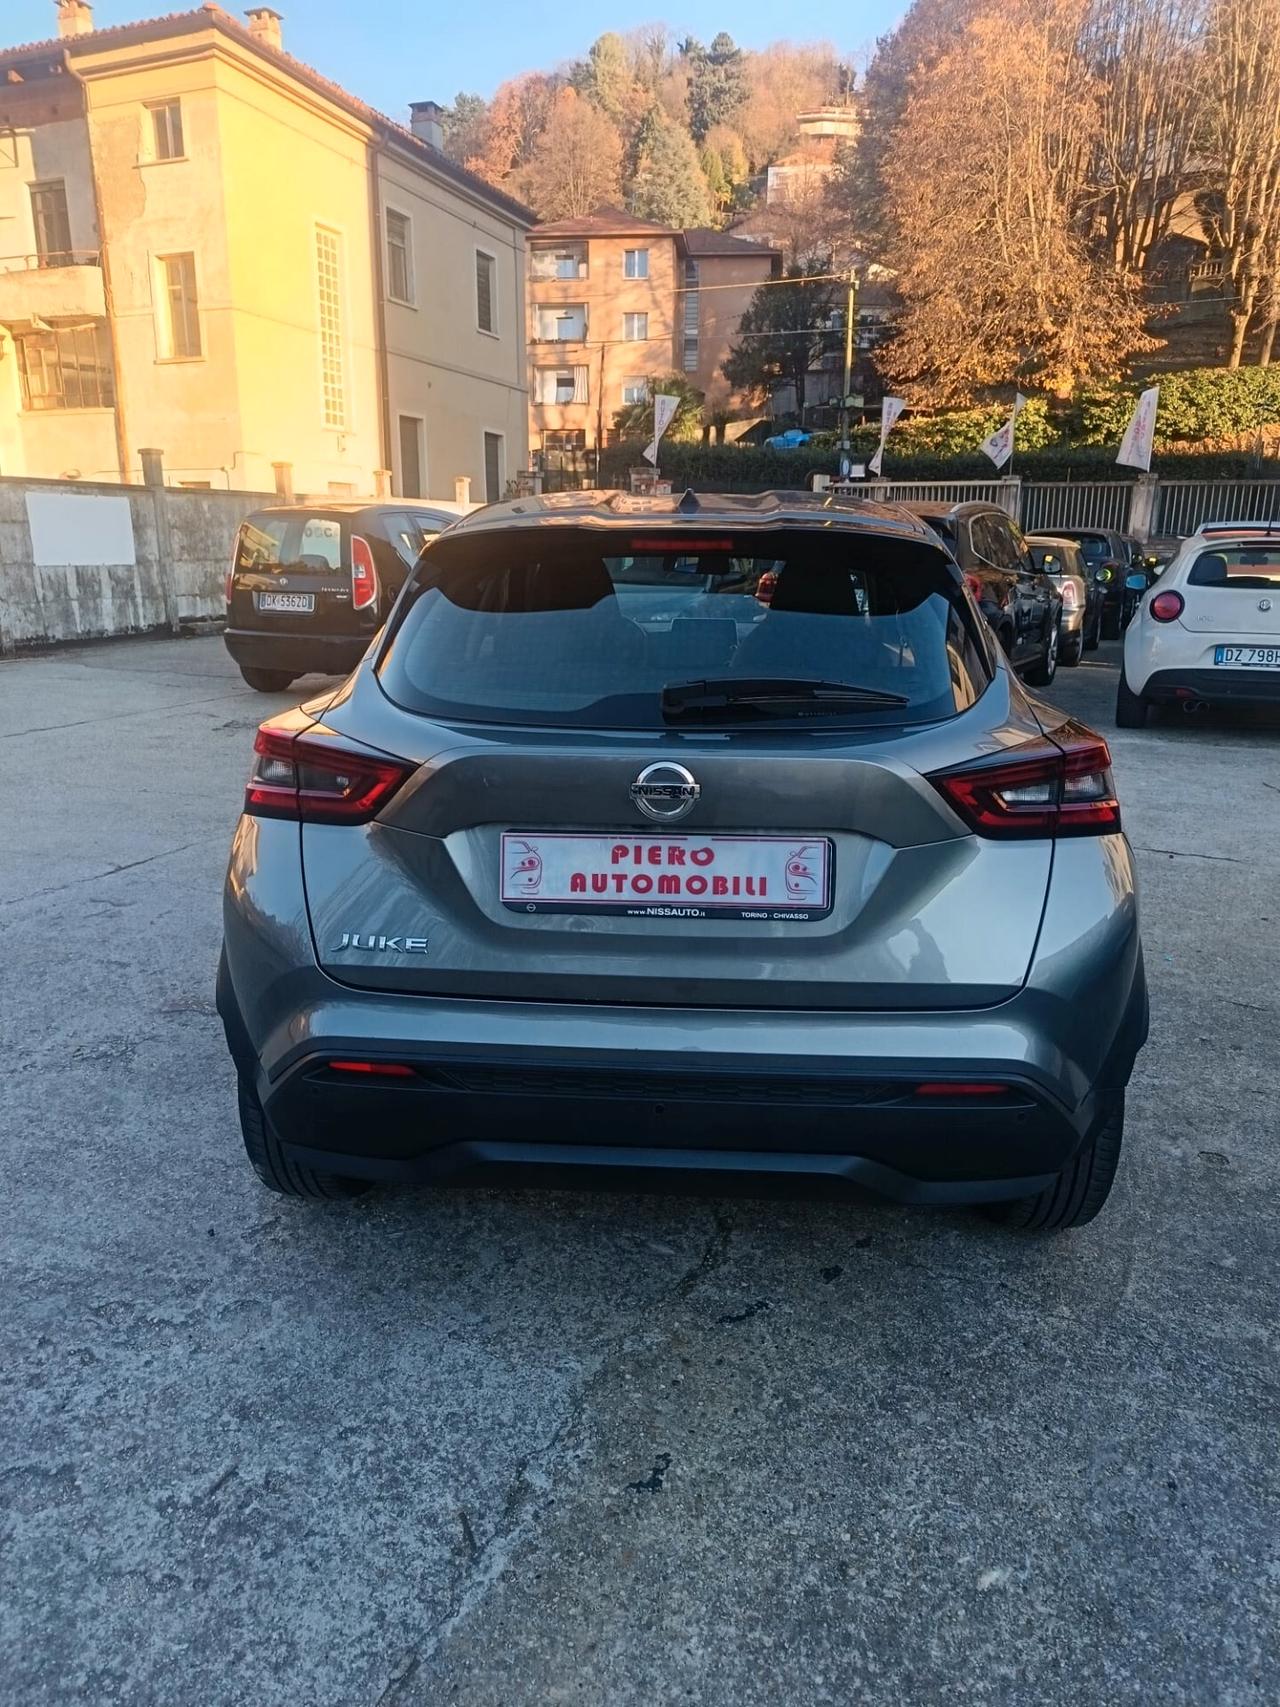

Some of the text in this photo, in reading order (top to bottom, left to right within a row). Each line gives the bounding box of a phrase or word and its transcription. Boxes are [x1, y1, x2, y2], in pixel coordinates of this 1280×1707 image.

[266, 594, 277, 606] DK
[1225, 648, 1243, 662] DZ
[637, 785, 696, 798] NISSAN
[611, 844, 715, 867] PIERO
[570, 872, 767, 897] AUTOMOBILI
[627, 907, 706, 917] www.NISSAUTO.it
[741, 911, 768, 919] TORINO
[773, 912, 809, 920] CHIVASSO
[330, 933, 428, 954] JUKE
